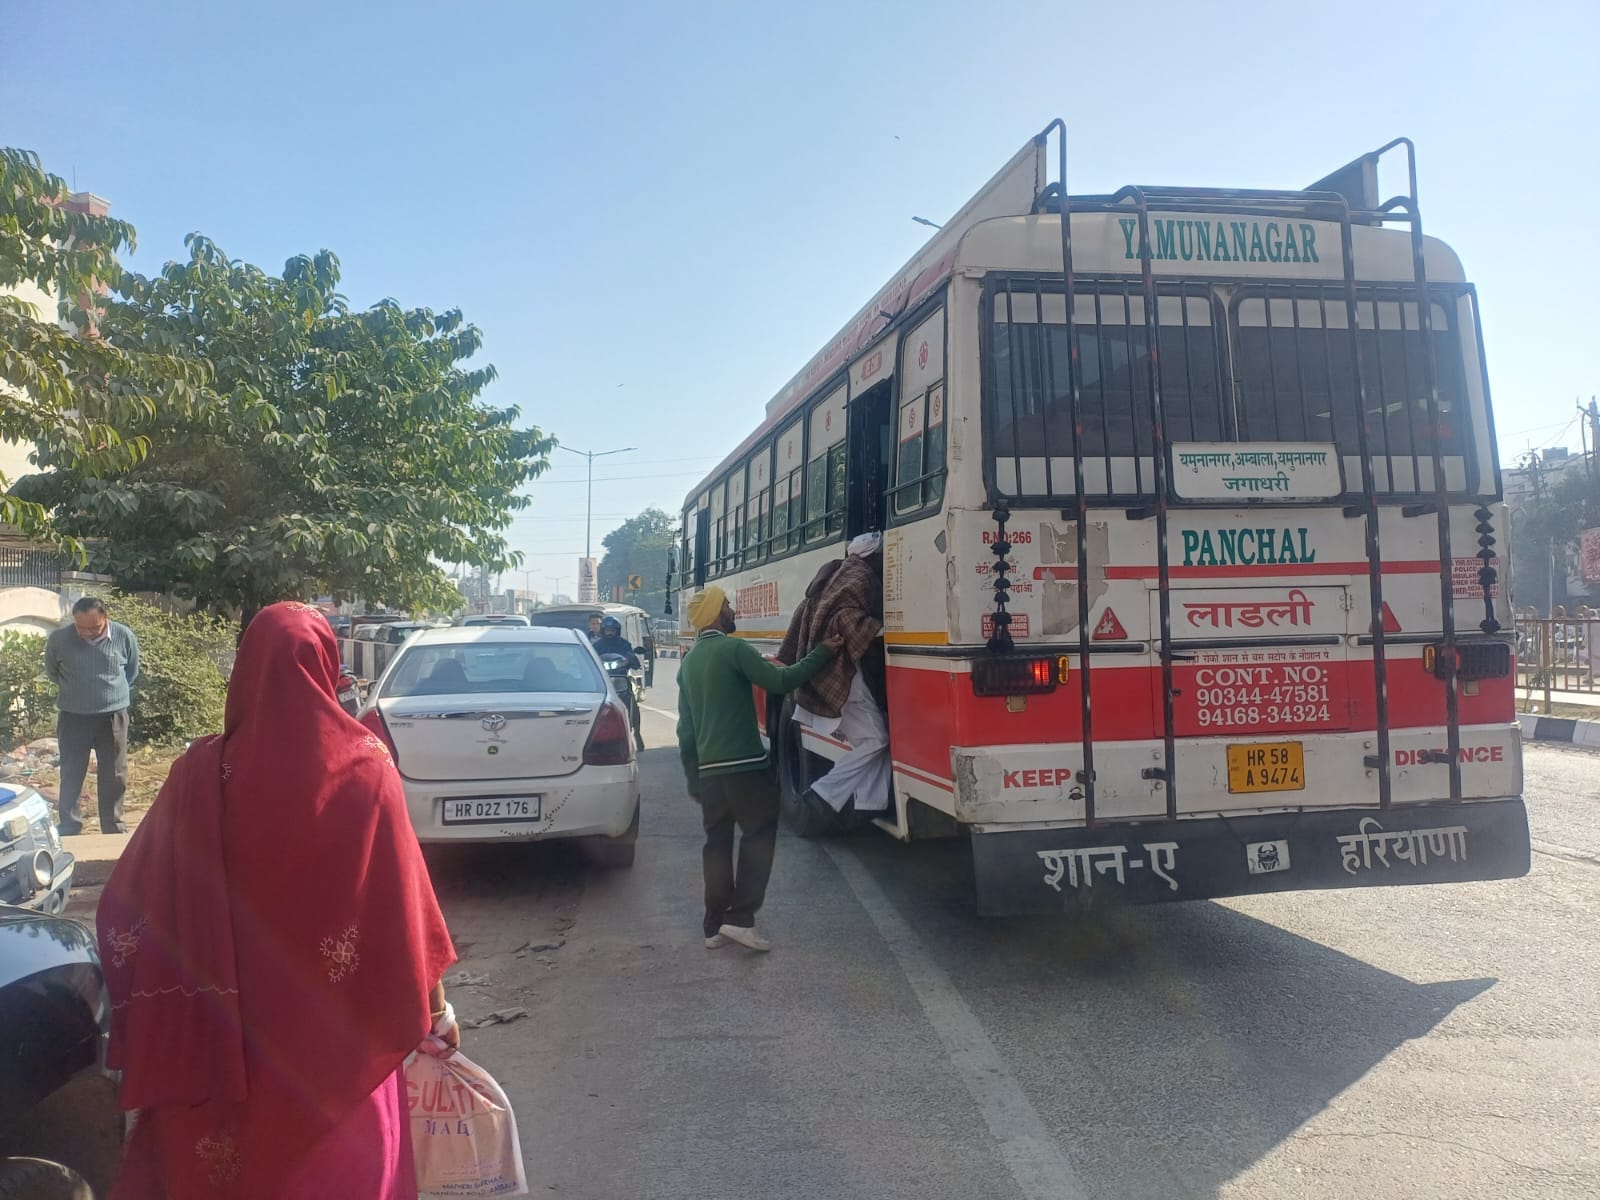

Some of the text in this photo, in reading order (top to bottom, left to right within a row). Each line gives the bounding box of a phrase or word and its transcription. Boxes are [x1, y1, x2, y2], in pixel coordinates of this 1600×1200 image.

[1222, 471, 1290, 492] जगाधरी
[1182, 528, 1316, 566] PANCHAL
[1183, 589, 1315, 629] लाडली
[1222, 654, 1238, 663] शान
[1251, 653, 1264, 661] बस
[1197, 685, 1330, 707] 90344-47581
[1198, 704, 1330, 727] 94168-34324
[1247, 748, 1288, 766] HR 58
[1395, 746, 1503, 766] DISNCE
[1003, 768, 1072, 788] KEEP
[1246, 767, 1299, 787] A 9474
[455, 803, 472, 817] HR
[506, 802, 529, 815] 176
[1335, 816, 1468, 875] हरियाणा
[1037, 842, 1180, 892] शान-ए
